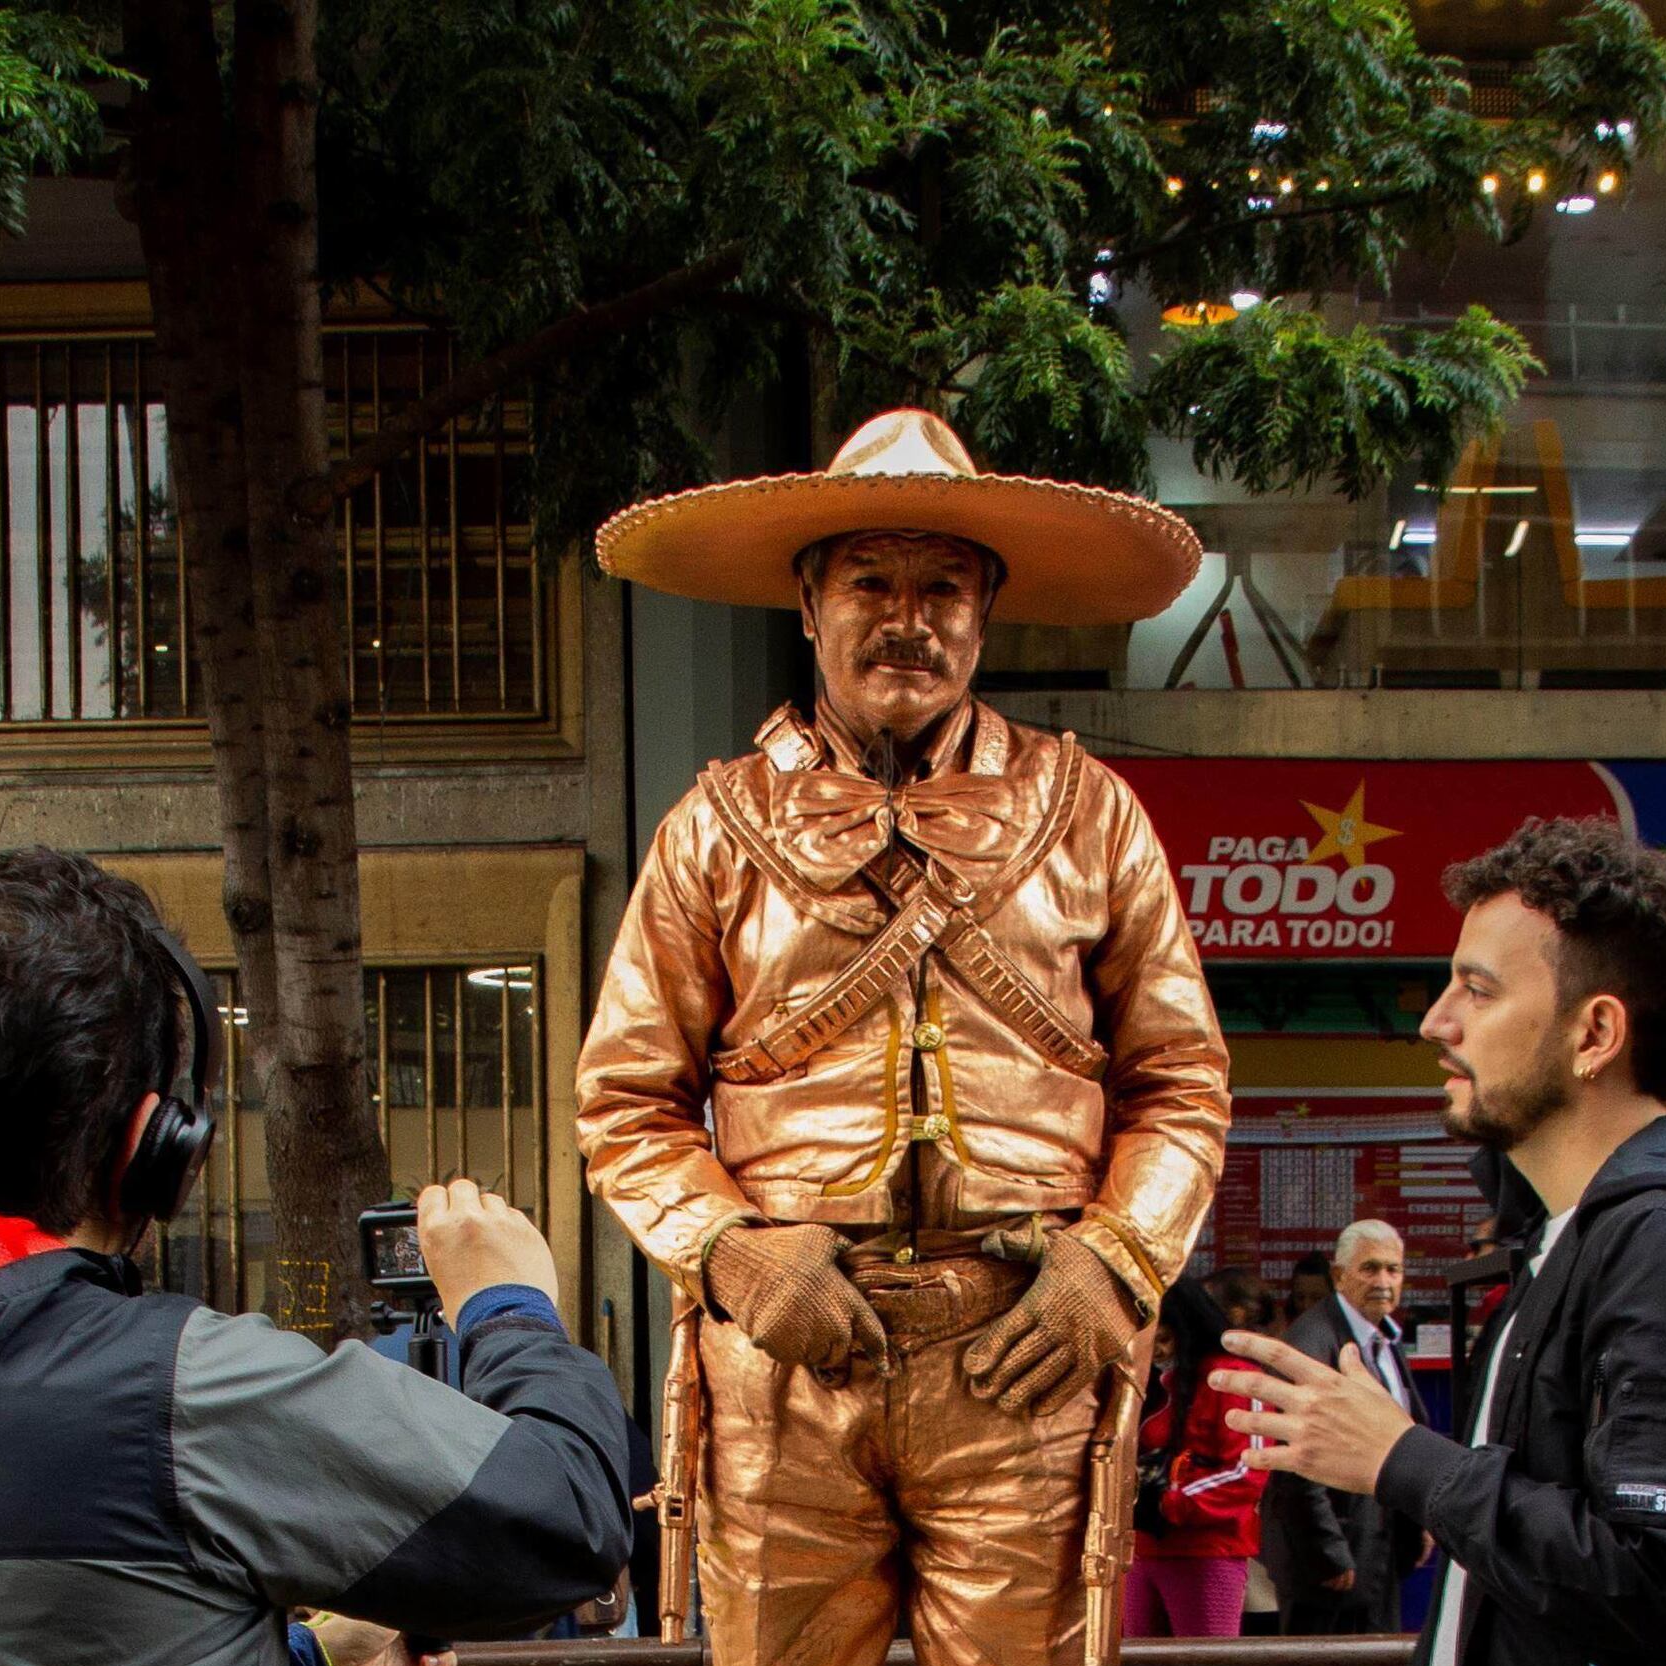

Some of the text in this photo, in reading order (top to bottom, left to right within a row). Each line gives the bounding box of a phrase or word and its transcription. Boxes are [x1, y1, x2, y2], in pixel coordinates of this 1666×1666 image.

[1207, 836, 1310, 862] PAGA
[1180, 864, 1396, 916] TODO
[1186, 919, 1395, 947] PARA TODO!
